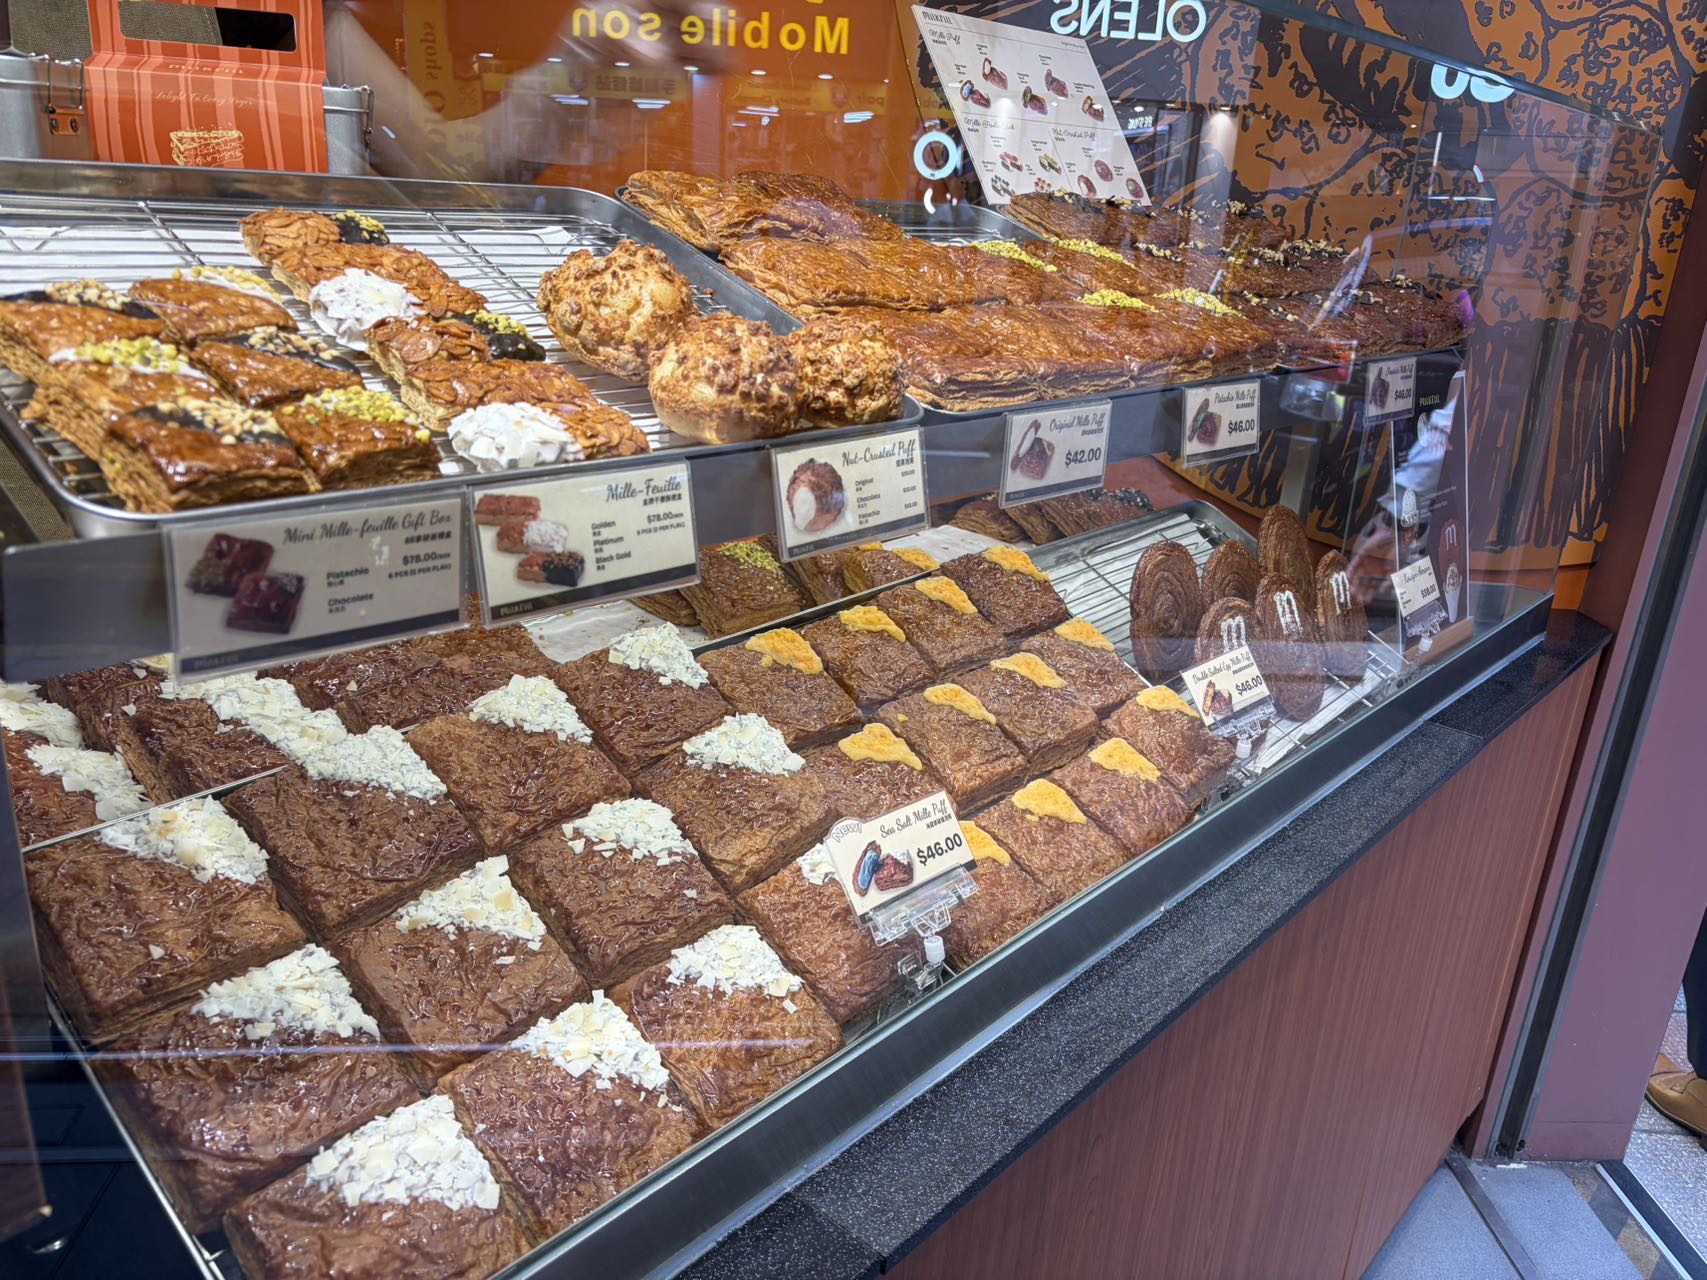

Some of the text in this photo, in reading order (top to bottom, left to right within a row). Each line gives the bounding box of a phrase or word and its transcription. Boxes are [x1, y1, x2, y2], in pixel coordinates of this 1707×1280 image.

[153, 89, 186, 103] Delight
[1214, 387, 1256, 404] Pistachio Mille Puff
[1049, 415, 1075, 433] Original
[1075, 413, 1091, 427] Mille
[1092, 411, 1106, 428] Puff
[1227, 419, 1255, 436] $46.00
[842, 442, 896, 468] Nut-Crusted
[897, 438, 916, 457] Puff
[1064, 447, 1102, 468] $42.00
[605, 477, 681, 503] Mille-Feuille
[855, 477, 874, 487] Original
[282, 526, 316, 545] Mini
[319, 515, 399, 541] Mille-feuille
[401, 511, 426, 533] Gift
[429, 509, 452, 525] Box
[591, 520, 616, 531] Golden
[593, 536, 624, 547] Platinum
[595, 551, 632, 565] Black Gold
[327, 567, 370, 580] Pistachio
[328, 593, 374, 606] Chocolate
[1420, 584, 1437, 600] $38.00
[1208, 661, 1223, 678] Salted
[1222, 659, 1232, 673] Egg
[1230, 654, 1242, 667] Mille
[1235, 675, 1263, 697] $46.00
[879, 824, 896, 839] Sea
[895, 814, 913, 832] Salt
[913, 806, 933, 825] Mille
[931, 799, 948, 817] Puff
[916, 832, 963, 867] $46.00
